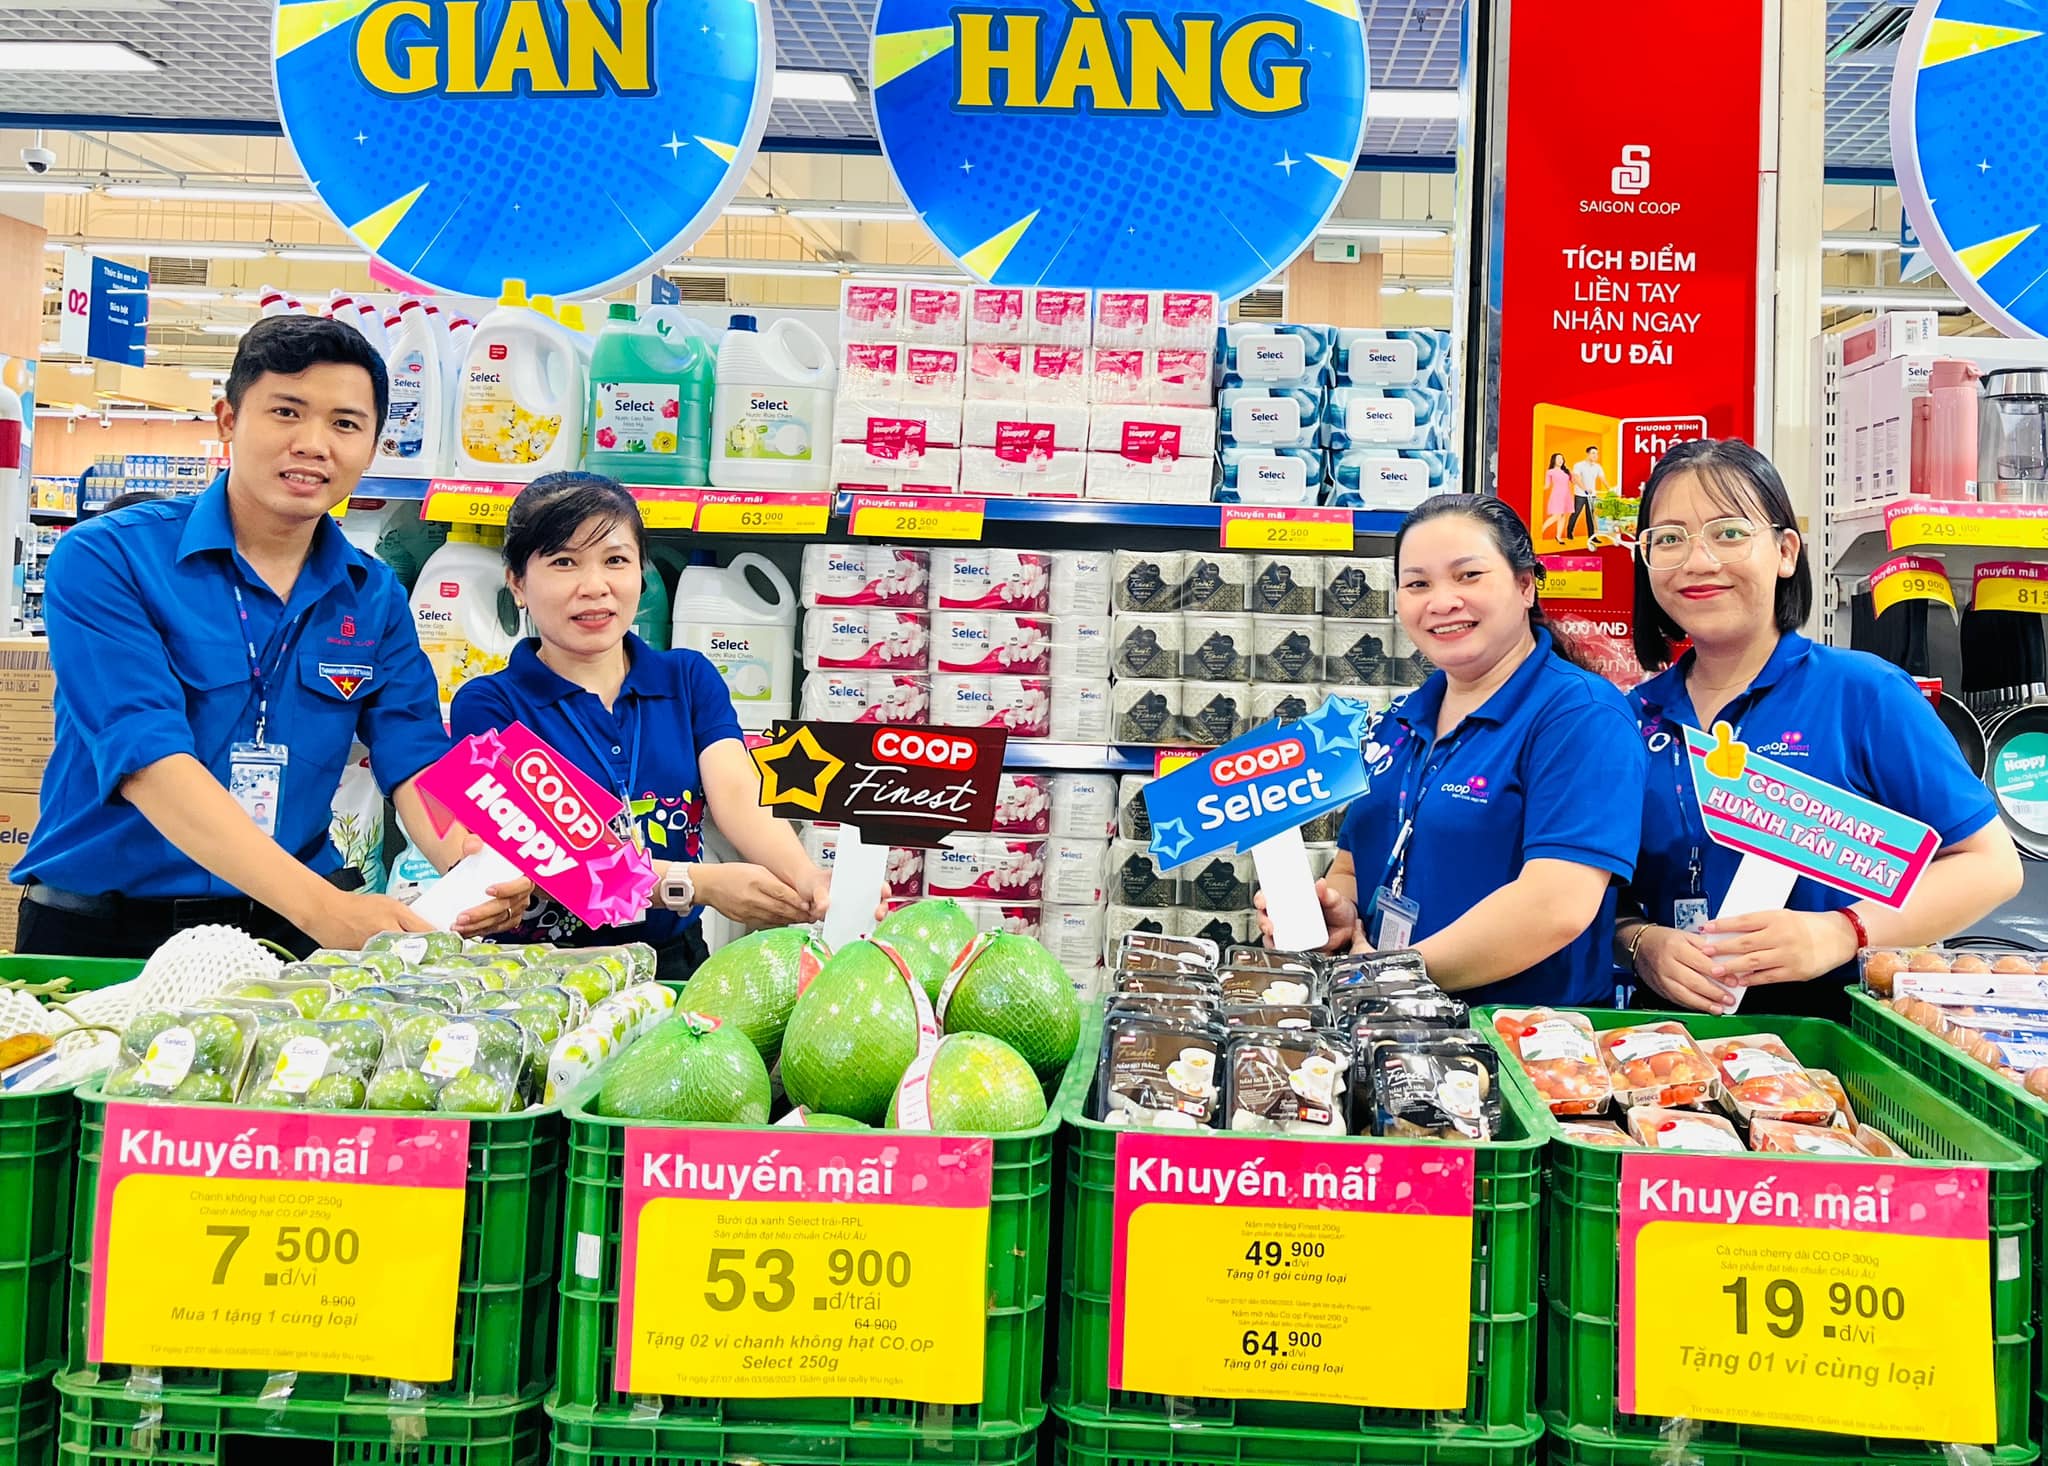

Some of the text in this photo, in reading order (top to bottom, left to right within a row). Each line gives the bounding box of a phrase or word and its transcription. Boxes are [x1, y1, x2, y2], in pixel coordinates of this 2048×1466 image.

[356, 0, 655, 94] GIAN
[957, 0, 1305, 112] HÀNG
[1579, 200, 1681, 214] SAIGON CO.OP
[1562, 243, 1696, 272] TÍCH ĐIỂM
[1574, 274, 1681, 303] LIỀN TAY
[68, 288, 88, 316] 02
[1553, 306, 1701, 334] NHẬN NGAY
[1580, 339, 1673, 365] ƯU ĐÃI
[394, 378, 421, 388] Select
[470, 372, 501, 383] Select
[615, 399, 655, 412] Select
[751, 399, 789, 411] Select
[433, 482, 472, 494] Khuyến
[702, 494, 741, 505] Khuyến
[857, 498, 896, 508] Khuyến
[1226, 509, 1286, 520] Khuyến mãi
[1887, 503, 1927, 519] Khuyến
[828, 560, 865, 572] Select
[954, 564, 990, 576] Select
[1870, 563, 1897, 586] Khuyến
[1976, 566, 2039, 578] Khuyến mãi
[418, 610, 453, 621] Select
[832, 623, 869, 634] Select
[952, 627, 988, 639] Select
[1591, 622, 1628, 636] VNĐ
[711, 638, 750, 651] Select
[829, 685, 865, 697] Select
[956, 689, 993, 702] Select
[877, 732, 973, 765] COOP
[1214, 742, 1300, 783] COOP
[2004, 754, 2047, 772] Happy
[843, 762, 978, 813] Finest
[1072, 784, 1095, 794] Select
[519, 755, 598, 840] COOP
[1196, 768, 1331, 831] Select
[1748, 774, 1886, 847] CO.OPMART
[464, 772, 579, 877] Happy
[1707, 786, 1901, 890] HUỲNH TẤN PHÁT
[941, 850, 977, 864] Select
[1060, 850, 1083, 860] Select
[1063, 917, 1086, 927] Select
[119, 1128, 369, 1177] Khuyến mãi
[641, 1149, 893, 1201] Khuyến mãi
[1128, 1157, 1377, 1204] Khuyến mãi
[1638, 1175, 1890, 1224] Khuyến mãi
[760, 1215, 785, 1226] xanh
[787, 1215, 820, 1227] Select
[275, 1226, 360, 1265] 500
[1290, 1241, 1325, 1258] 900
[1716, 1244, 1731, 1256] Cà
[1732, 1246, 1759, 1258] chua
[1759, 1246, 1793, 1262] cherry
[1794, 1247, 1810, 1261] dài
[1851, 1252, 1880, 1268] 300g
[827, 1248, 912, 1288] 900
[1225, 1268, 1347, 1285] Tặng 01 gói cùng loại
[828, 1290, 882, 1312] đ/trái
[1828, 1281, 1905, 1321] 900
[171, 1306, 206, 1322] Mua
[210, 1308, 220, 1322] 1
[224, 1308, 262, 1326] tặng
[267, 1309, 276, 1323] 1
[327, 1311, 358, 1327] loại
[646, 1330, 685, 1350] Tặng
[689, 1333, 709, 1348] 02
[732, 1332, 785, 1350] chanh
[789, 1334, 843, 1352] không
[847, 1333, 874, 1352] hạt
[879, 1335, 935, 1353] CO.OP
[1288, 1330, 1323, 1348] 900
[742, 1355, 839, 1372] Select 250g
[1223, 1358, 1344, 1376] Tặng 01 gói cùng loại
[1679, 1345, 1936, 1391] Tặng 01 vỉ cùng loại
